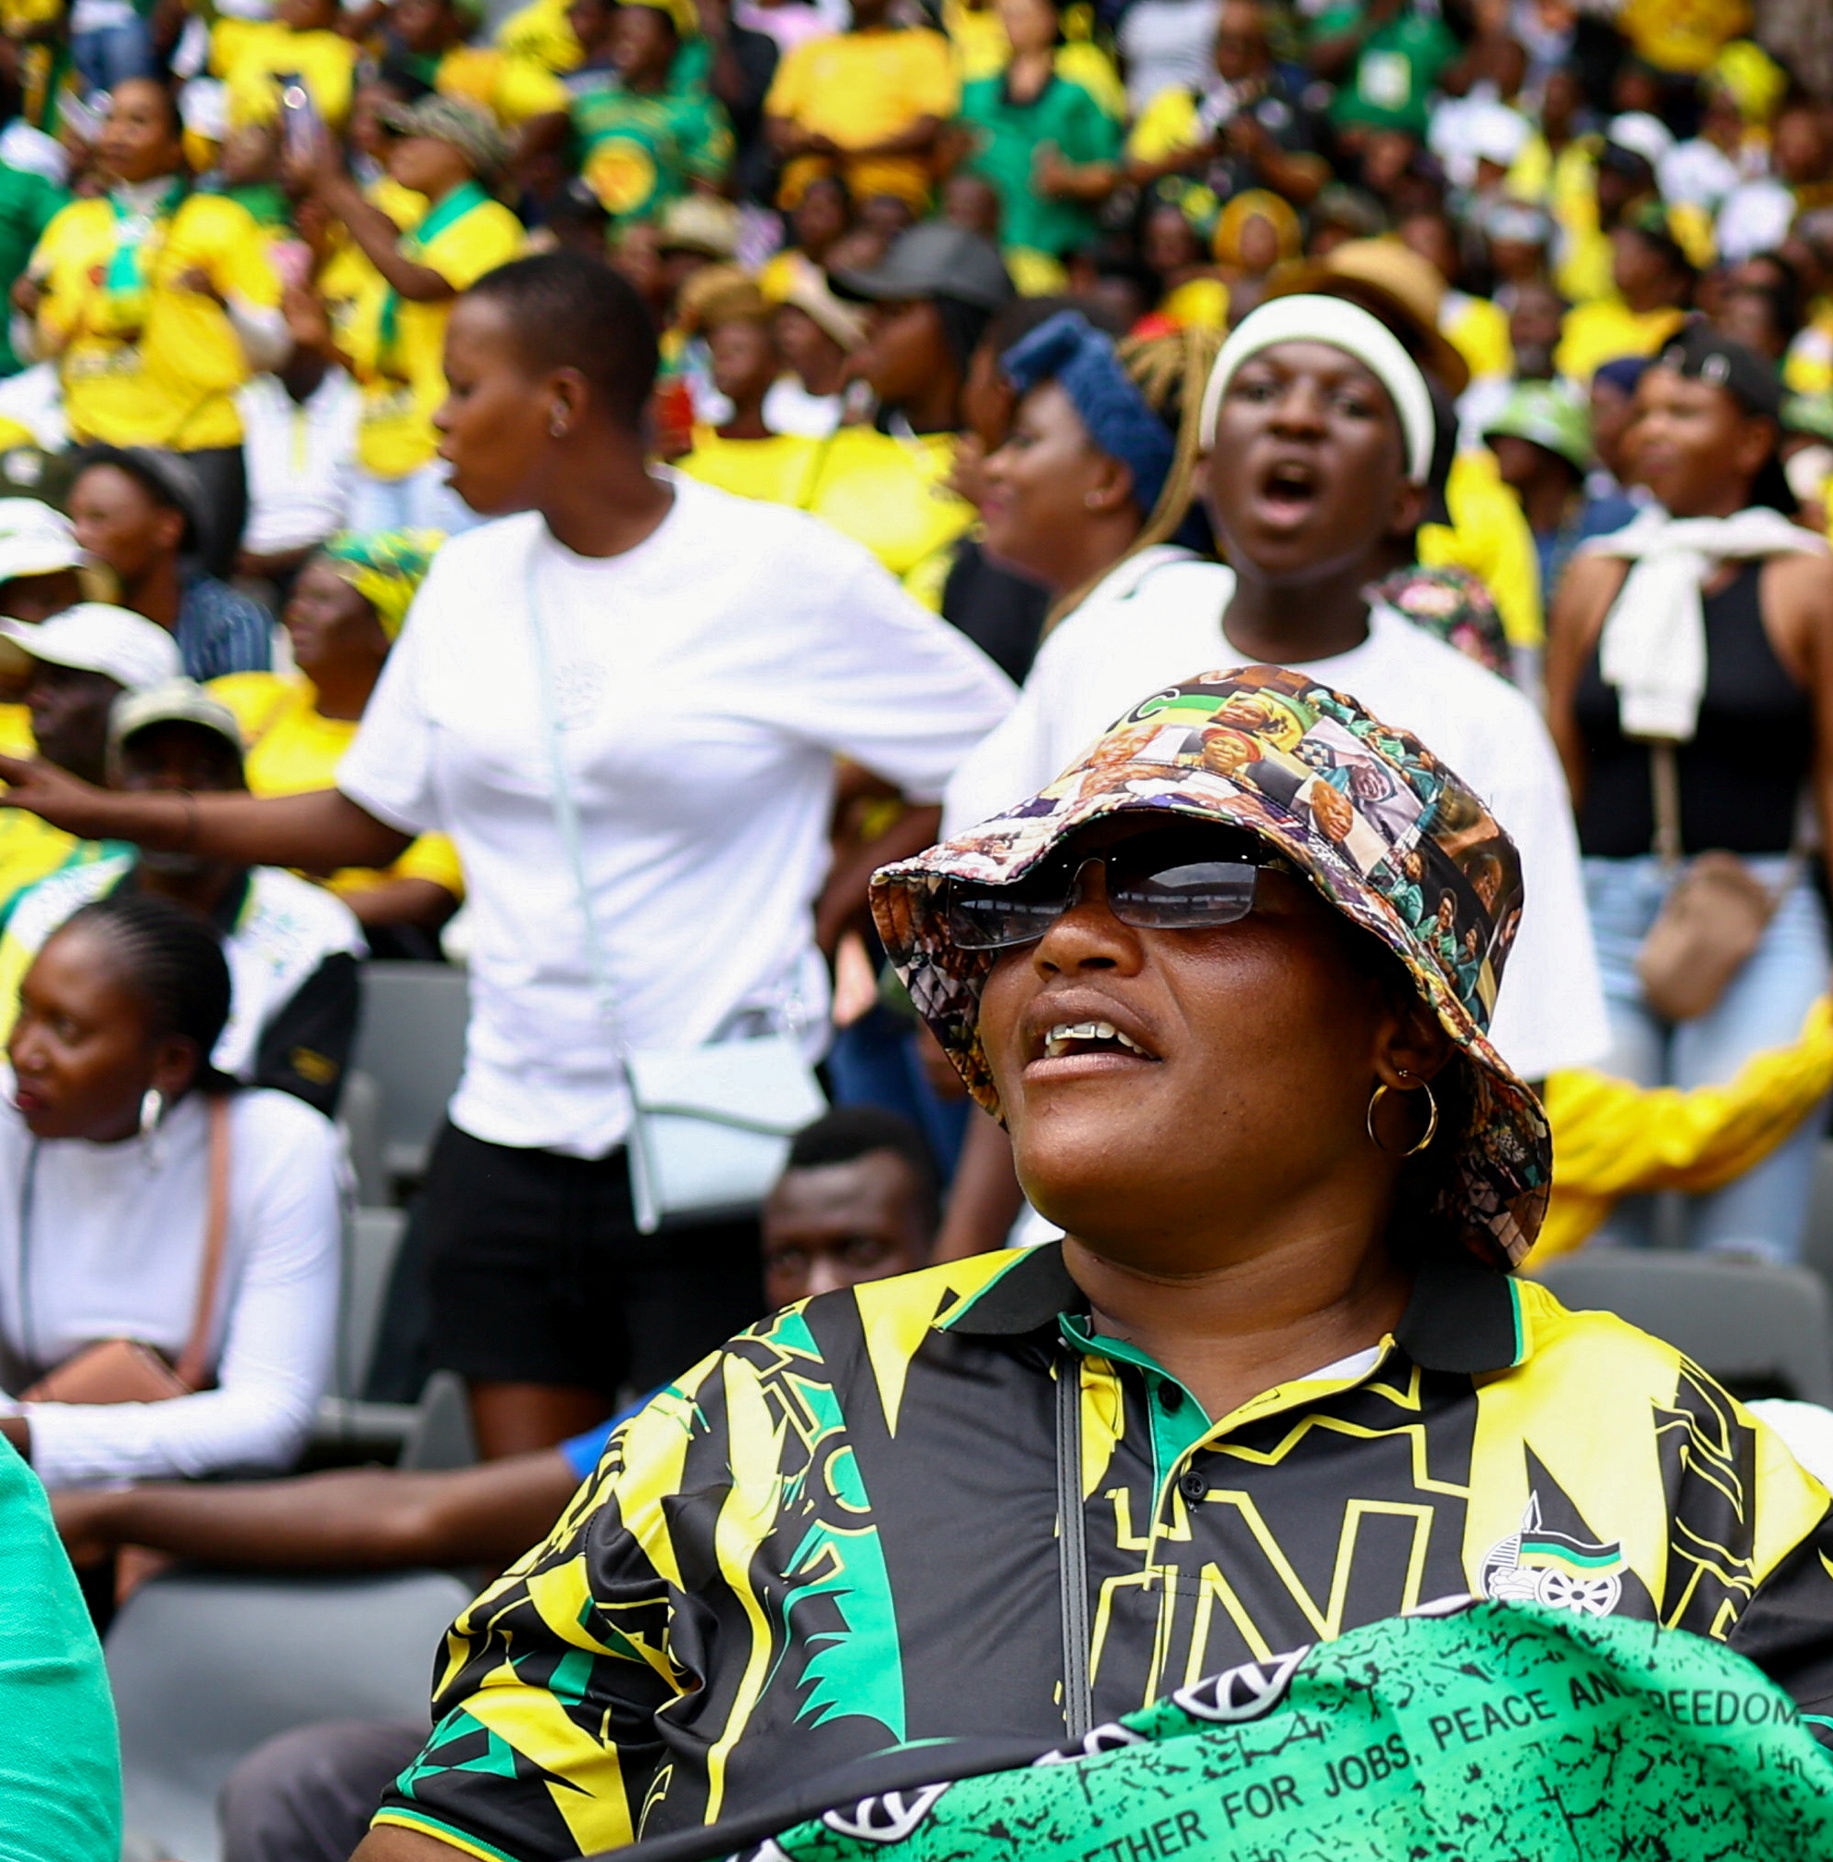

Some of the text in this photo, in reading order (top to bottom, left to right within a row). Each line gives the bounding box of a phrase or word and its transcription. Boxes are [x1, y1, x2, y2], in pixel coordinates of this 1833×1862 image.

[1221, 1776, 1300, 1830] FOR
[1324, 1733, 1412, 1796] JOBS,
[1433, 1688, 1556, 1753] PEACE
[1636, 1686, 1800, 1728] REEDOM
